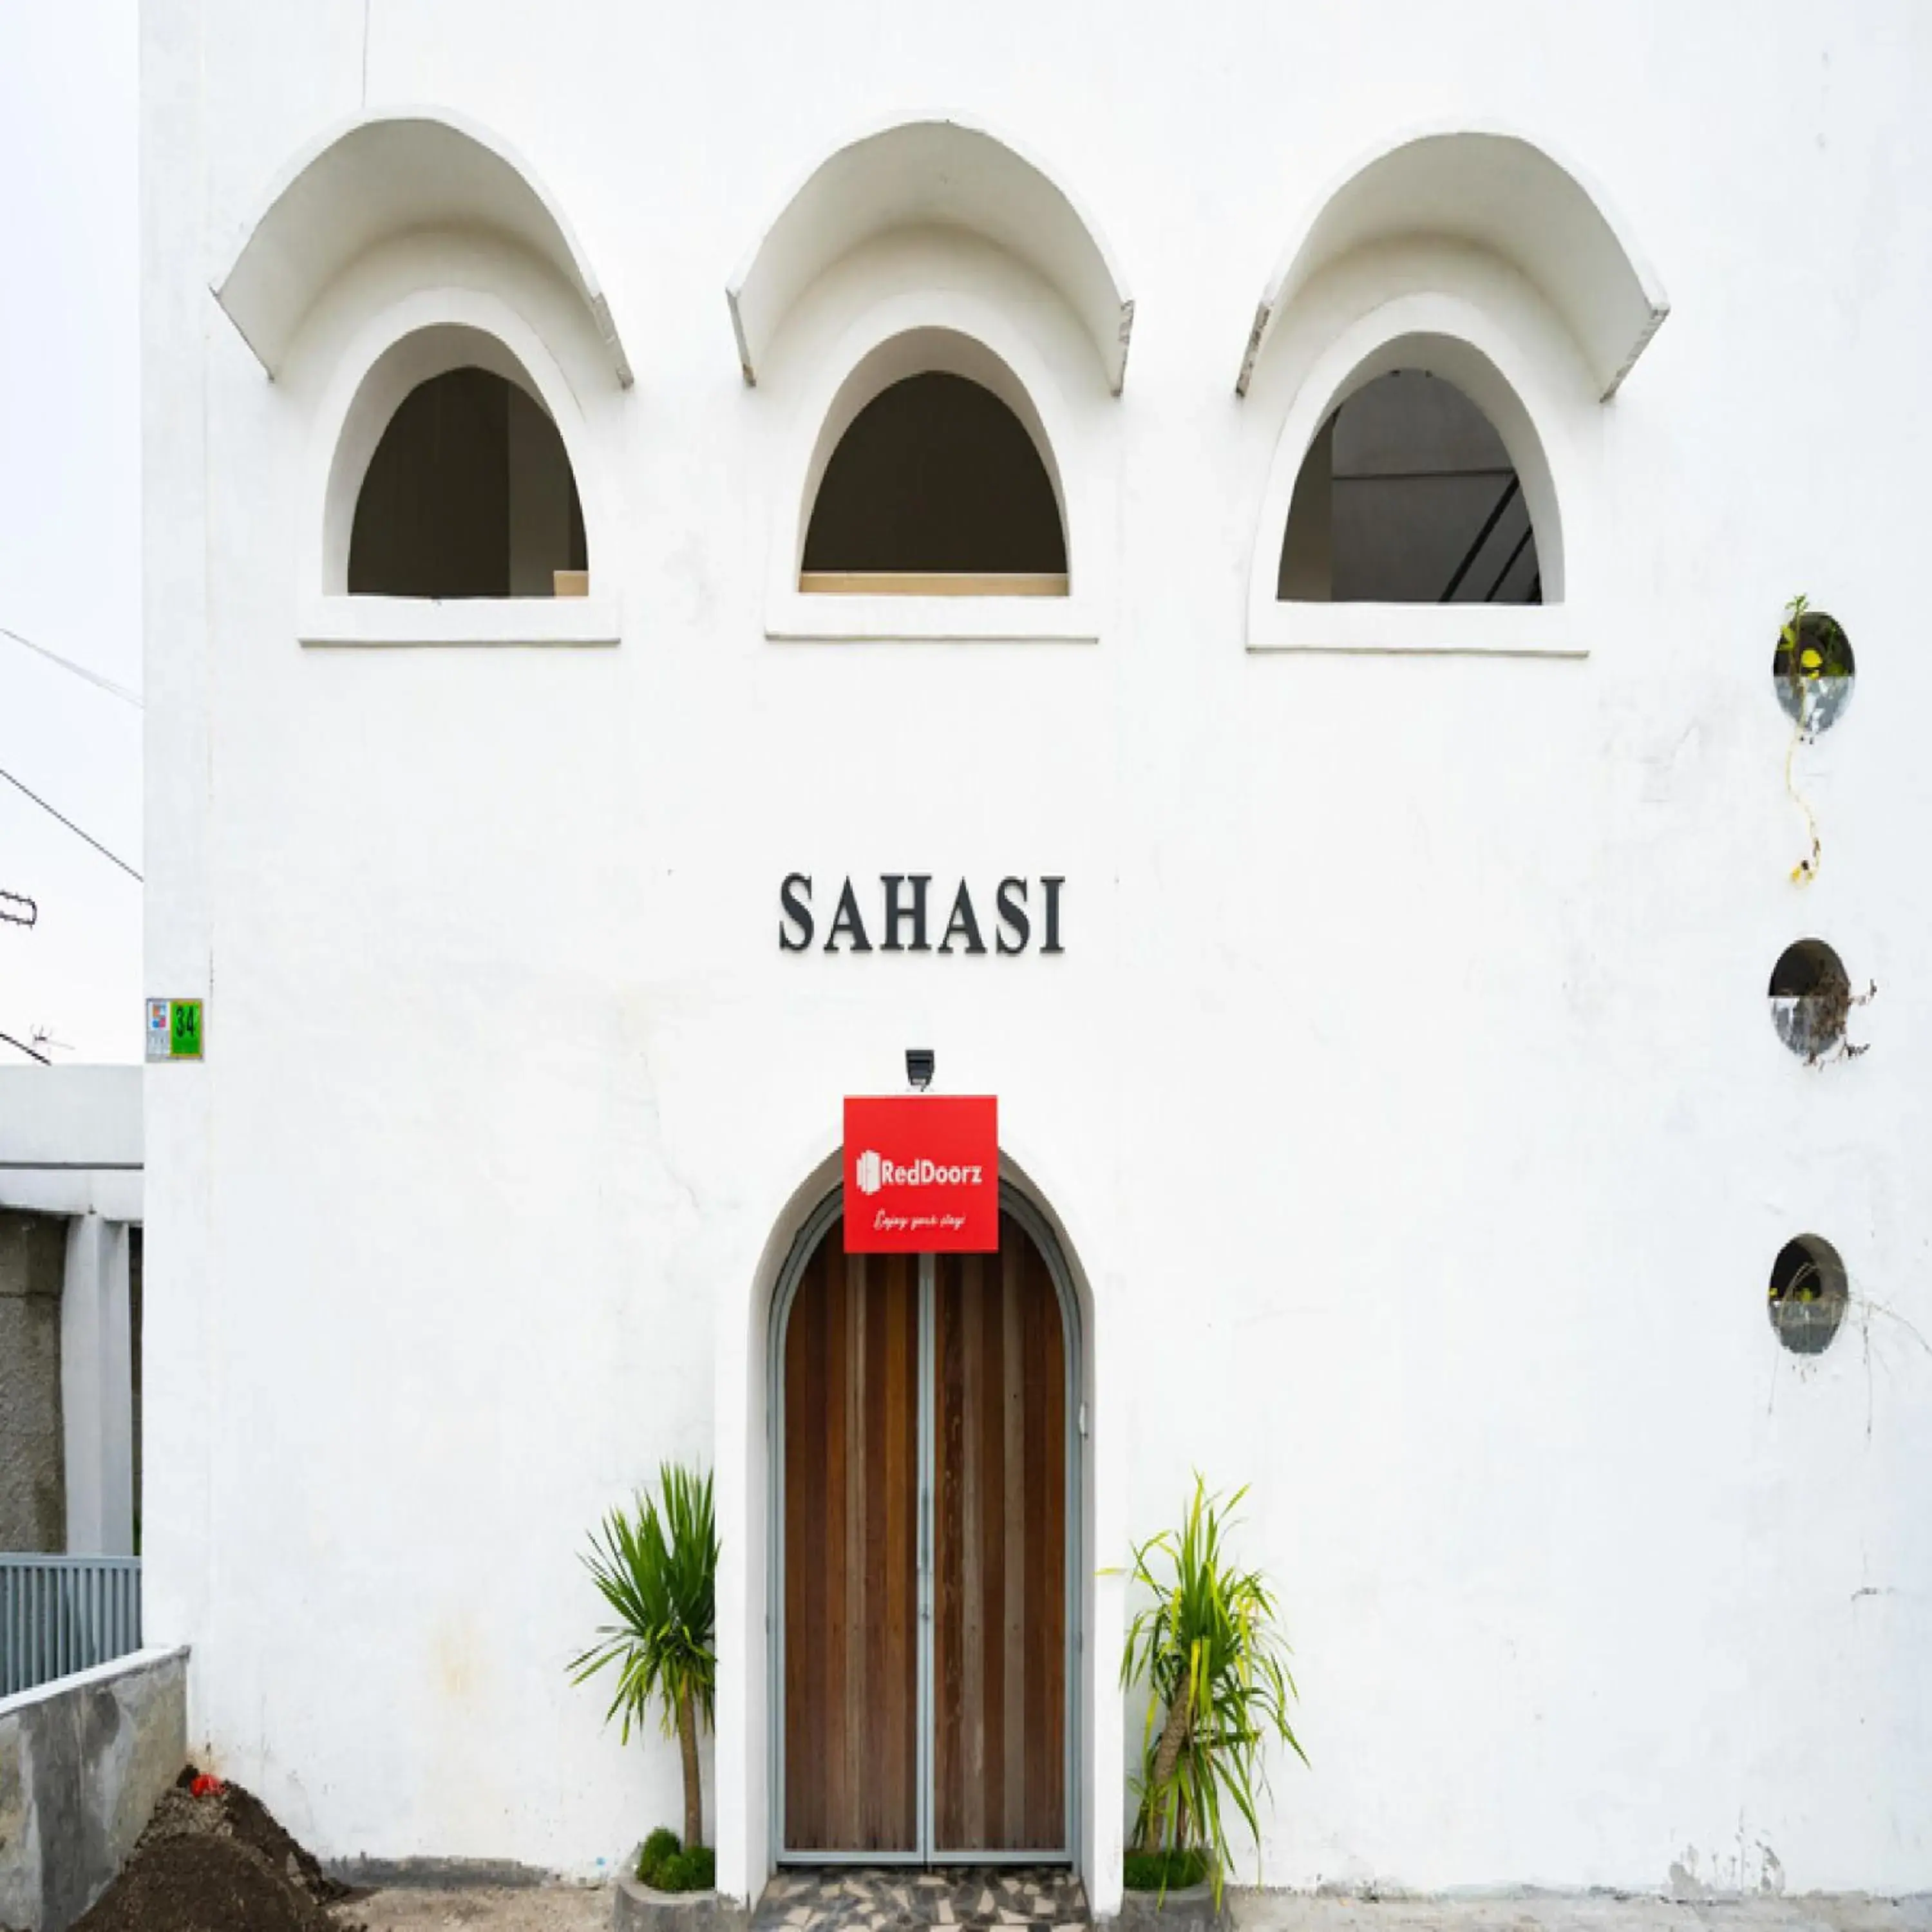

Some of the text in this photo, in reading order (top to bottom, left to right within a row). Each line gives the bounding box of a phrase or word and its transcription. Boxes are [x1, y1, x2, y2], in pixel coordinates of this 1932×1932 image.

[779, 873, 1066, 954] SAHASI
[176, 1005, 195, 1037] 34
[882, 1159, 983, 1185] RedDoorz
